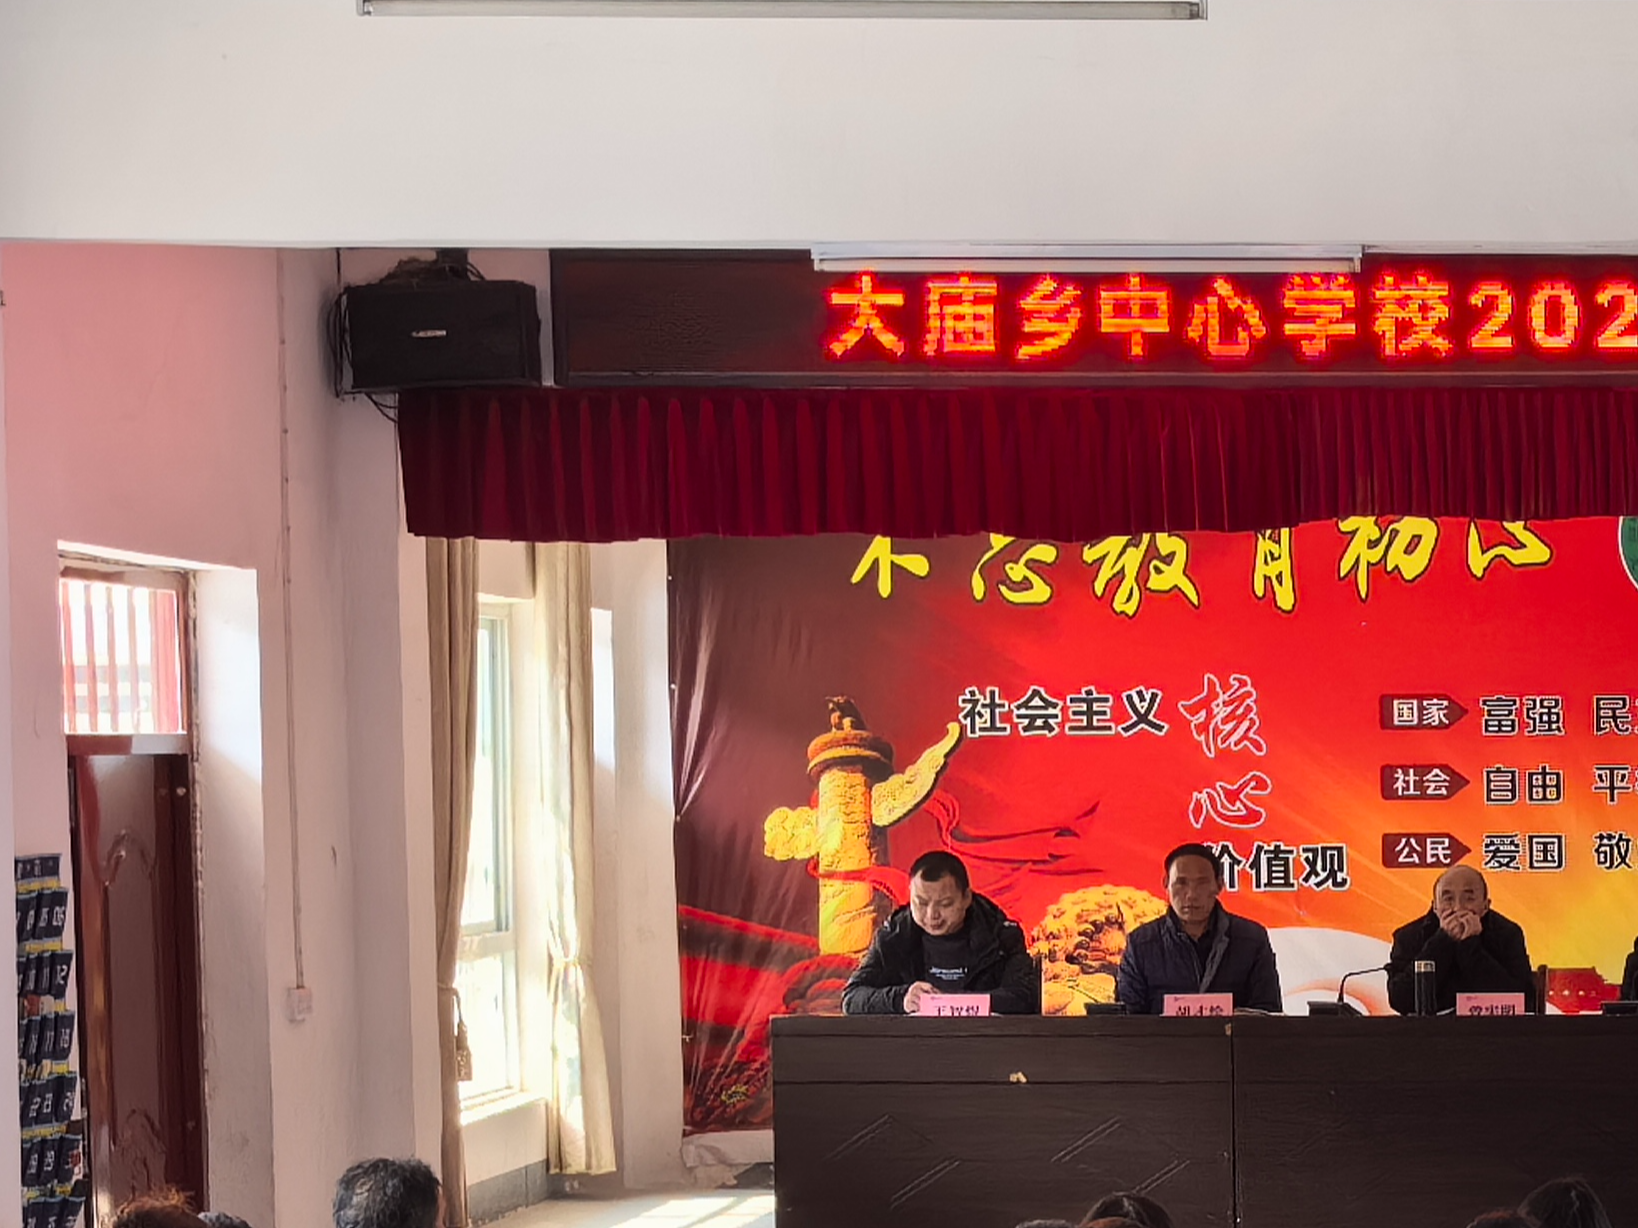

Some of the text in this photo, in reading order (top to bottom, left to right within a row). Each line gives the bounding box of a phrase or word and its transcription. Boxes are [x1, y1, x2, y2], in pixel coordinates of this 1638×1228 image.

[958, 686, 1170, 737] 社会主义
[1392, 697, 1450, 727] 国家
[1480, 695, 1566, 736] 富强
[1178, 672, 1273, 829] 核心
[1392, 767, 1451, 797] 社会
[1480, 764, 1566, 803] 自由
[1395, 837, 1452, 866] 公民
[1480, 832, 1566, 870] 爱国
